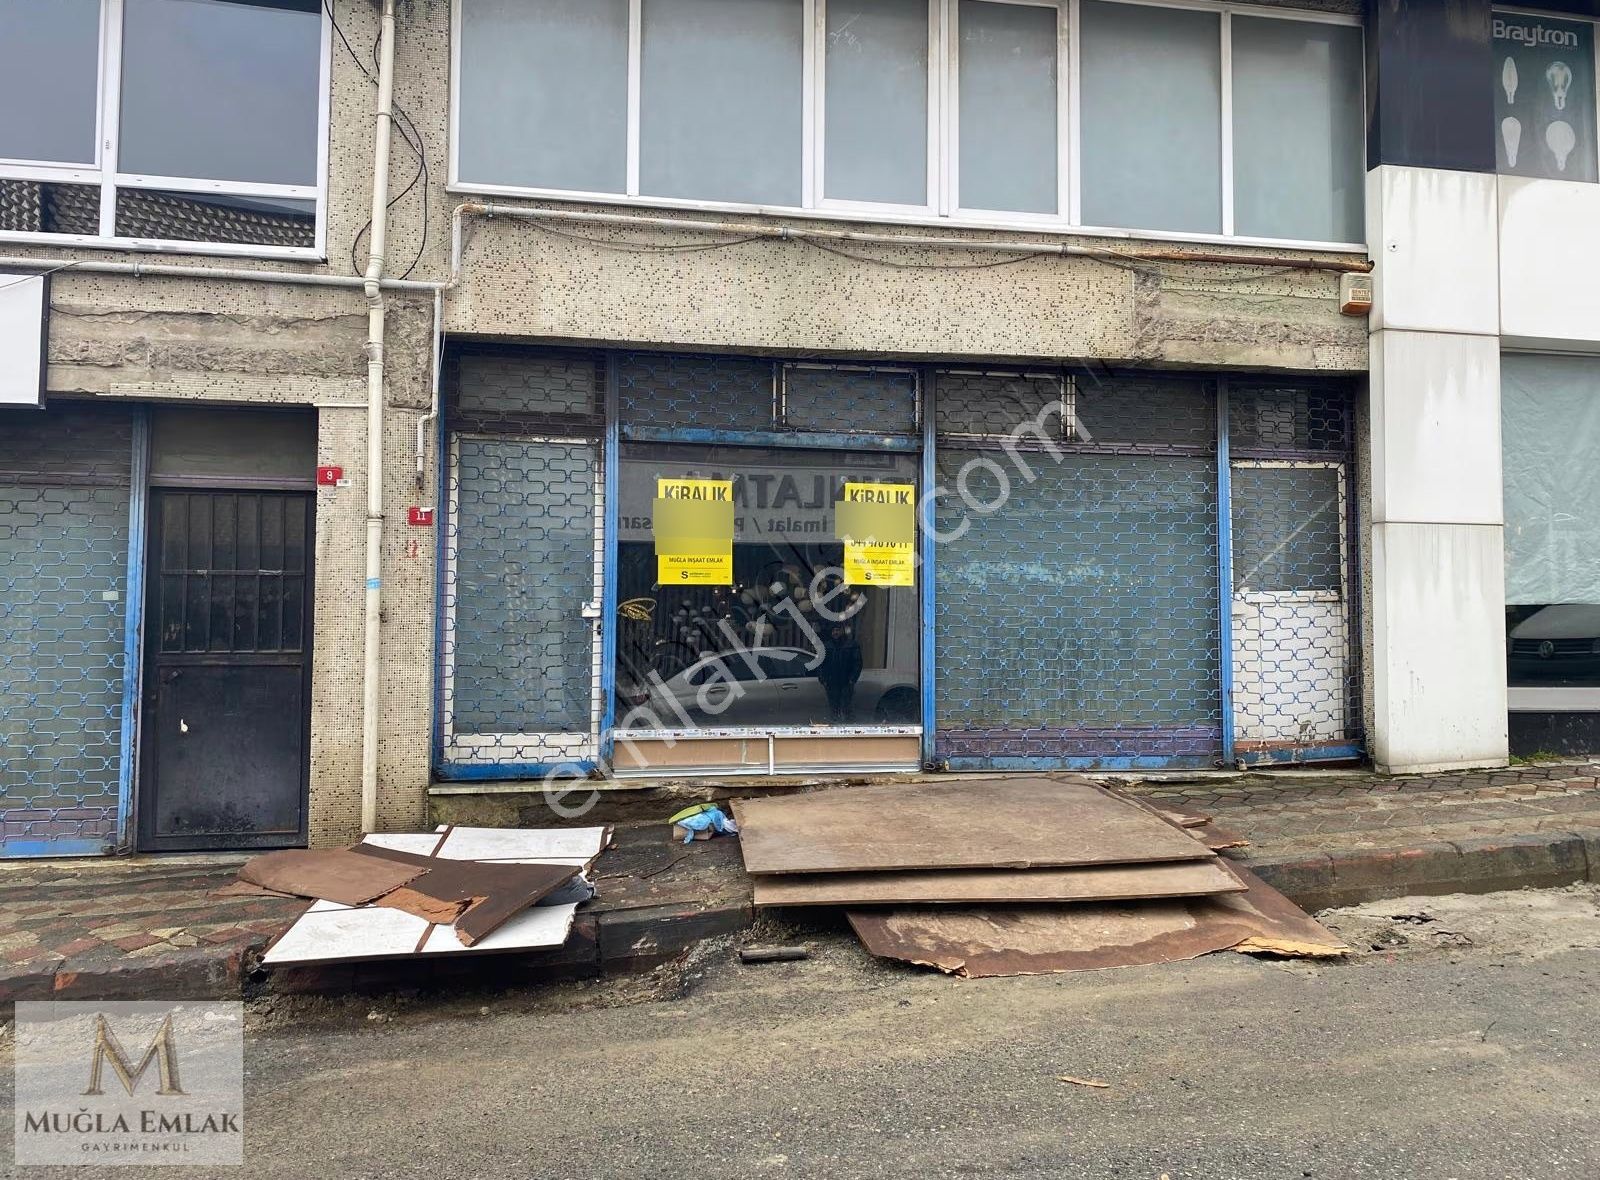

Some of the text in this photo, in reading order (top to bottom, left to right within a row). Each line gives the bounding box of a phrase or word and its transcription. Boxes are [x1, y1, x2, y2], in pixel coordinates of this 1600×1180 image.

[1493, 20, 1578, 47] Braytron
[326, 470, 333, 480] 9
[416, 511, 426, 521] 11
